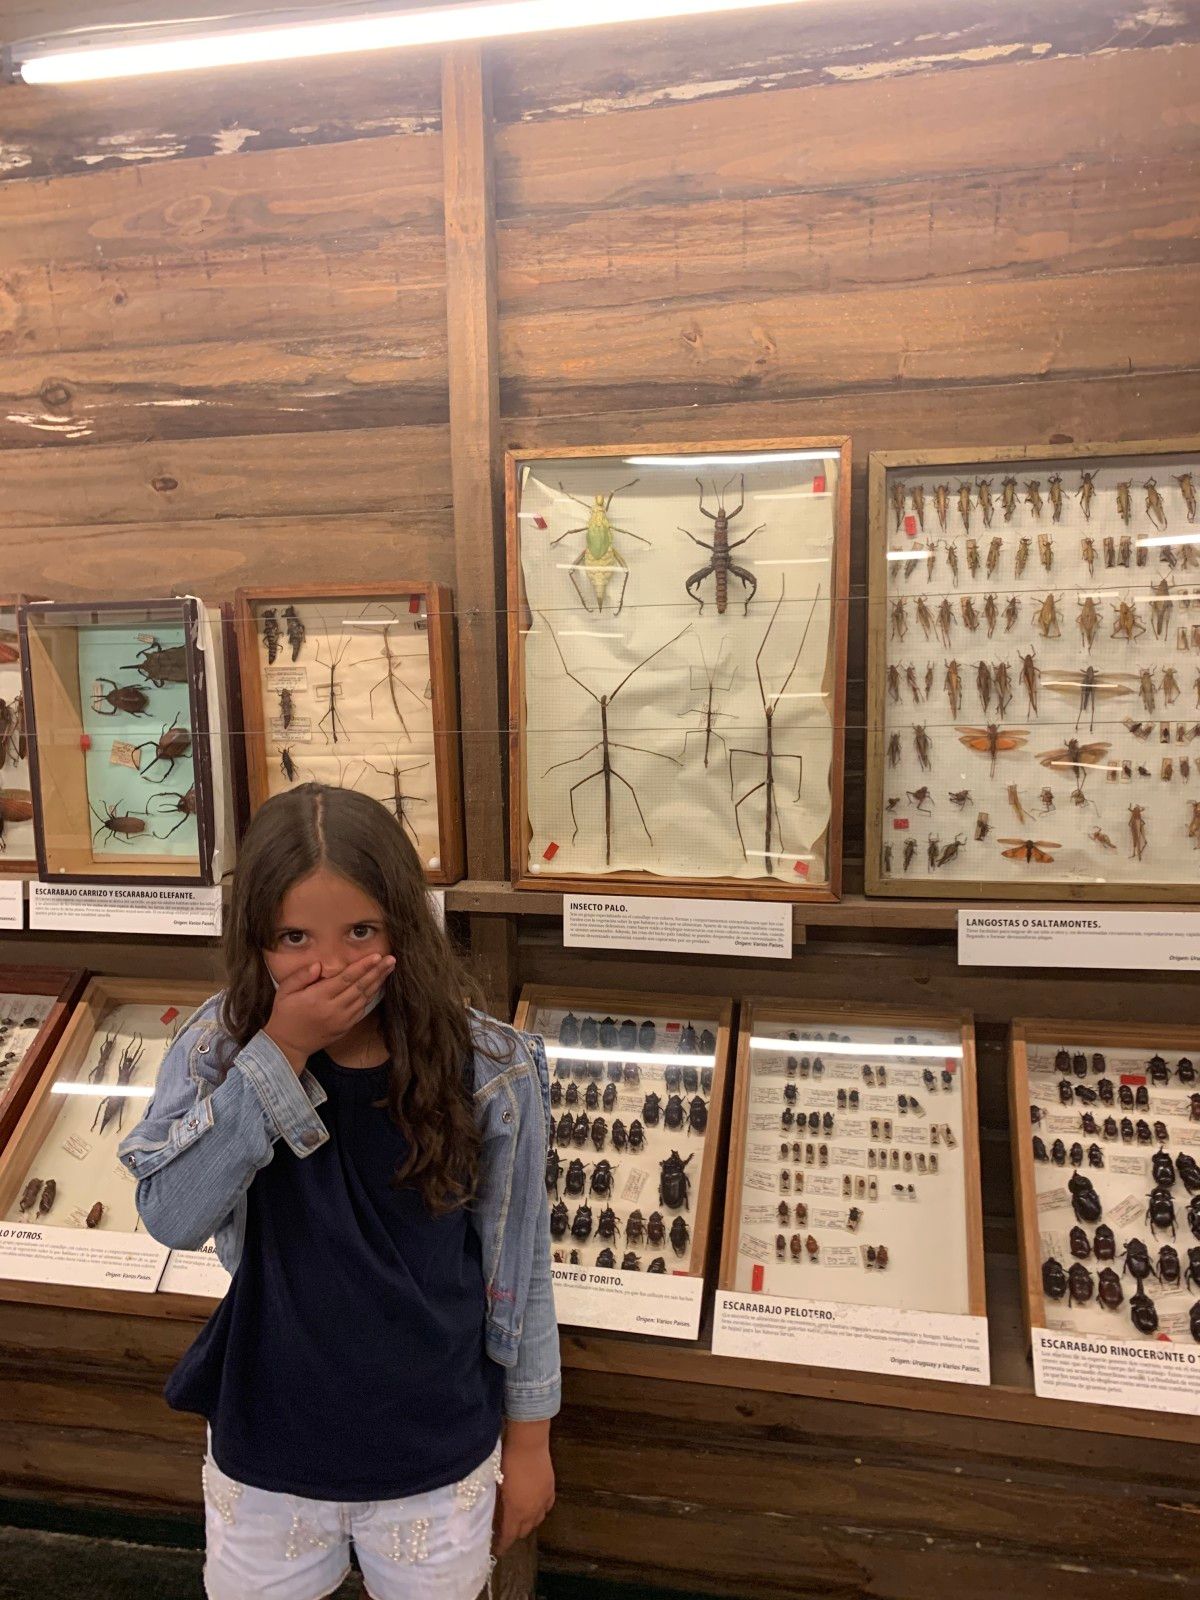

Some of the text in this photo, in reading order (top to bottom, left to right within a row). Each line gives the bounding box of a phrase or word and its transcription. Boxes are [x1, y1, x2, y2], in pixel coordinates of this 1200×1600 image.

[35, 888, 78, 897] ESCARABAJO
[78, 889, 108, 897] CARRIZO
[114, 890, 158, 899] ESCARABAJO
[159, 891, 196, 900] ELEFANTE.
[570, 902, 628, 912] INSECTO PALO.
[966, 918, 1101, 929] LANGOSTAS O SALTAMONTES.
[10, 1230, 16, 1238] Y
[16, 1230, 43, 1241] OTROS.
[580, 1273, 587, 1282] O
[589, 1274, 624, 1286] TORITO.
[722, 1300, 836, 1321] ESCARABAJO PELOTERO.
[1040, 1338, 1195, 1364] ESCARABAJO RINOCERONTE O
